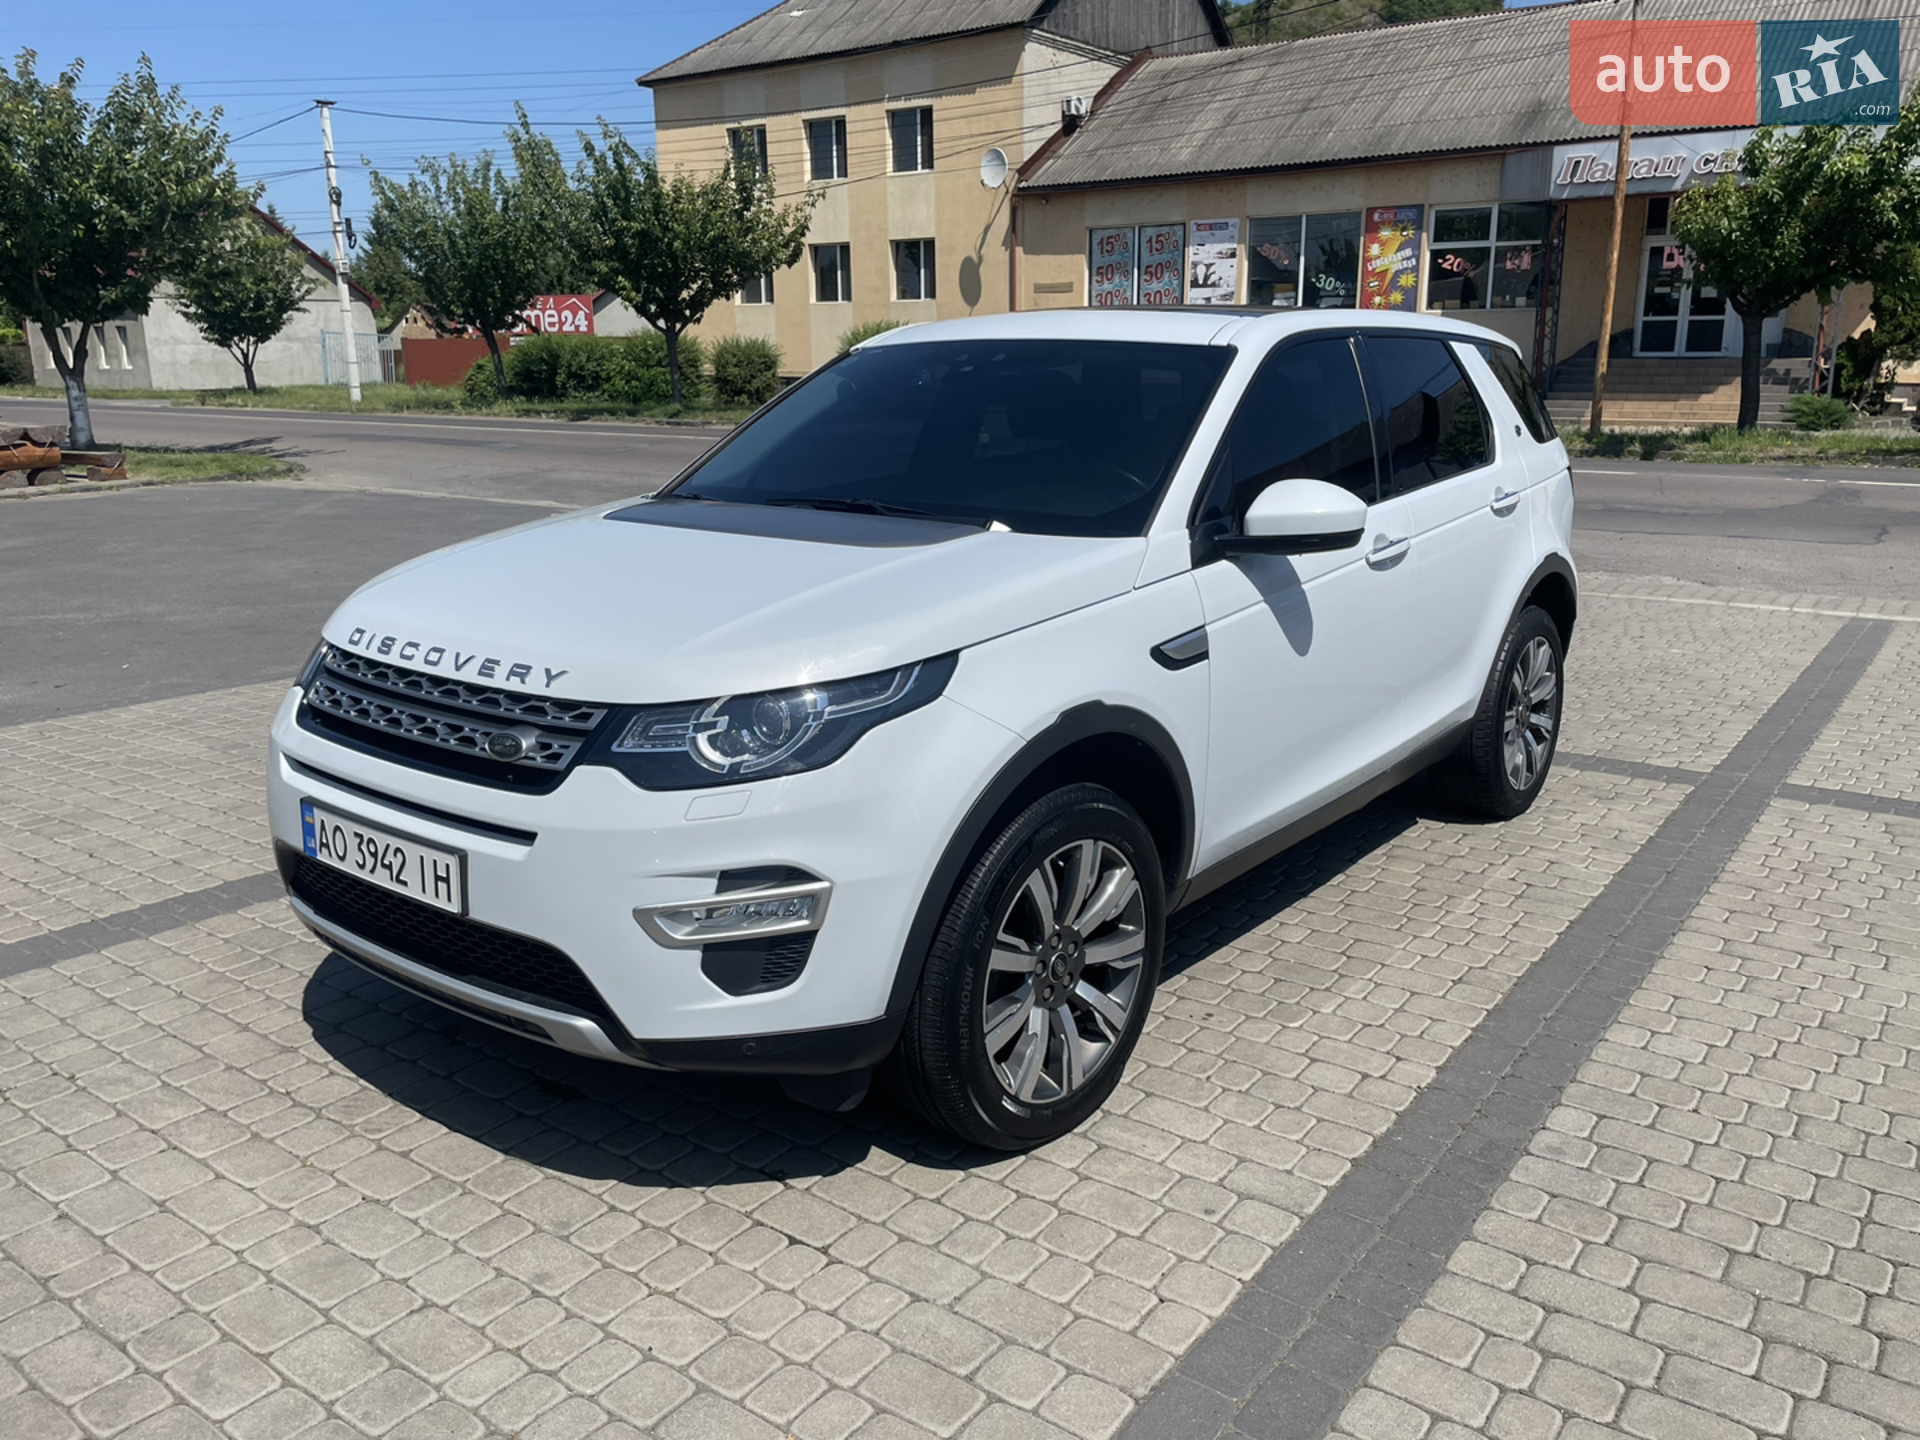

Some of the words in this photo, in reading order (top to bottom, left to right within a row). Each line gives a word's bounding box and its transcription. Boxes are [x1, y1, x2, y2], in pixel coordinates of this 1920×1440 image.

[1097, 231, 1129, 257] 15%
[1146, 229, 1179, 256] 15%
[1257, 243, 1291, 266] -50%
[1095, 260, 1130, 286] 50%
[1143, 258, 1180, 286] 50%
[1437, 254, 1476, 278] -20%
[1095, 287, 1129, 306] 30%
[1143, 286, 1180, 305] 30%
[1311, 273, 1346, 296] -30%
[348, 627, 570, 688] DISCOVERY
[319, 818, 348, 862] AO
[353, 830, 409, 888] 3942
[419, 854, 452, 904] IH
